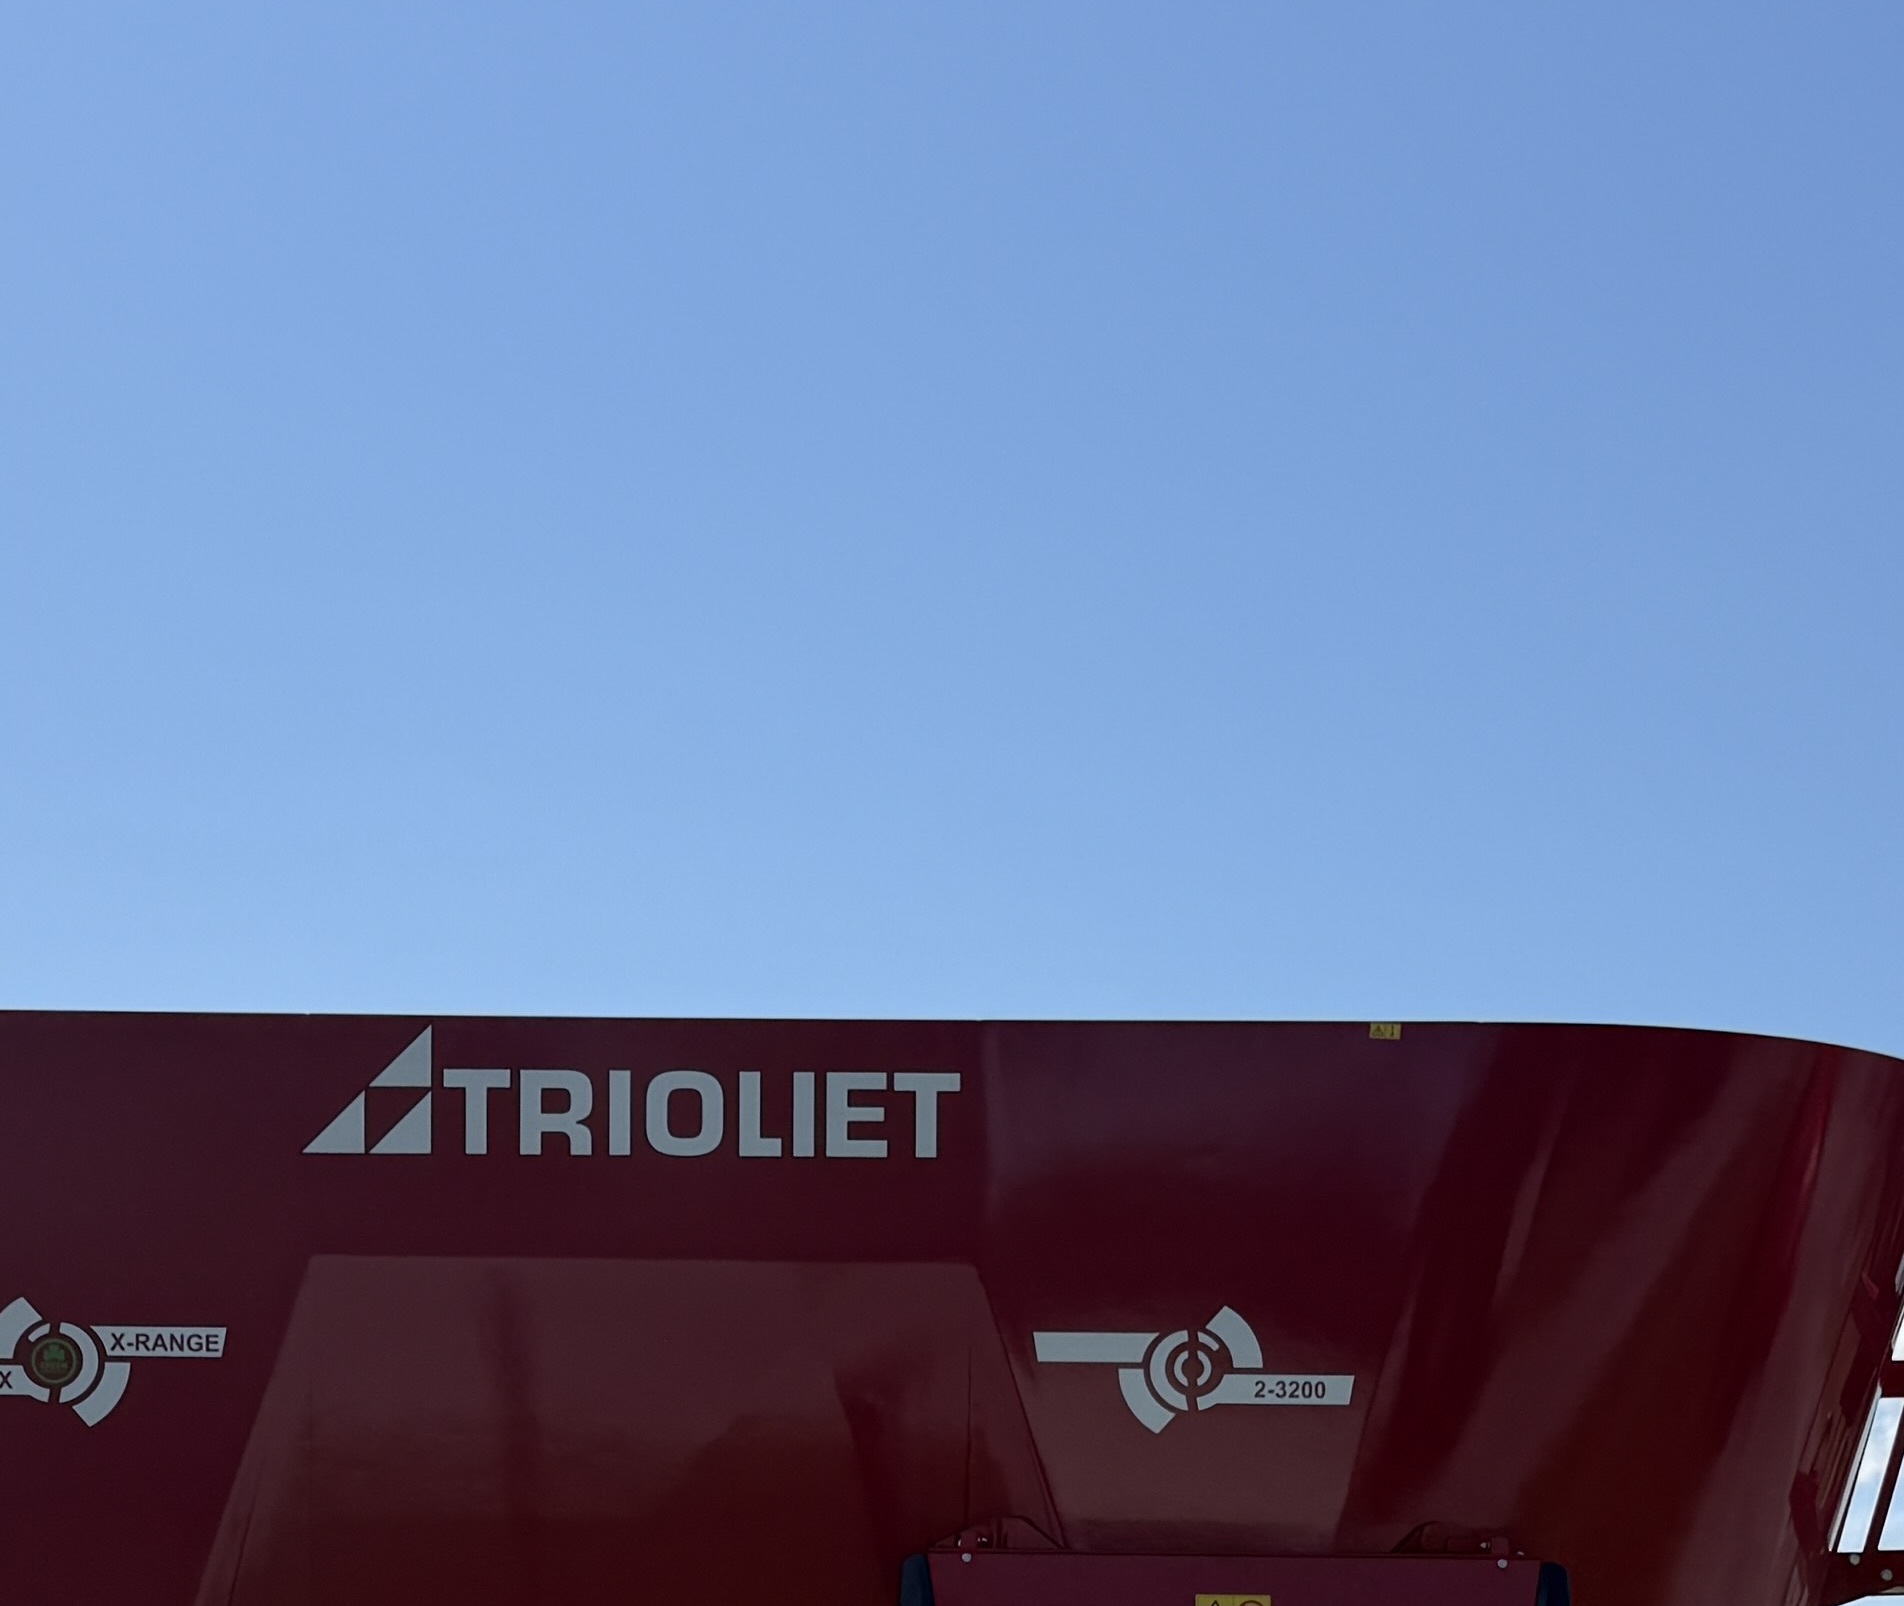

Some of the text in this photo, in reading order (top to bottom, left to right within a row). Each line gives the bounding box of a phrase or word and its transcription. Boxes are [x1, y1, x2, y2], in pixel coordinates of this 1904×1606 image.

[443, 1068, 961, 1159] TRIOLIET
[109, 1332, 220, 1353] X-RANGE
[1254, 1381, 1327, 1399] 2-3200
